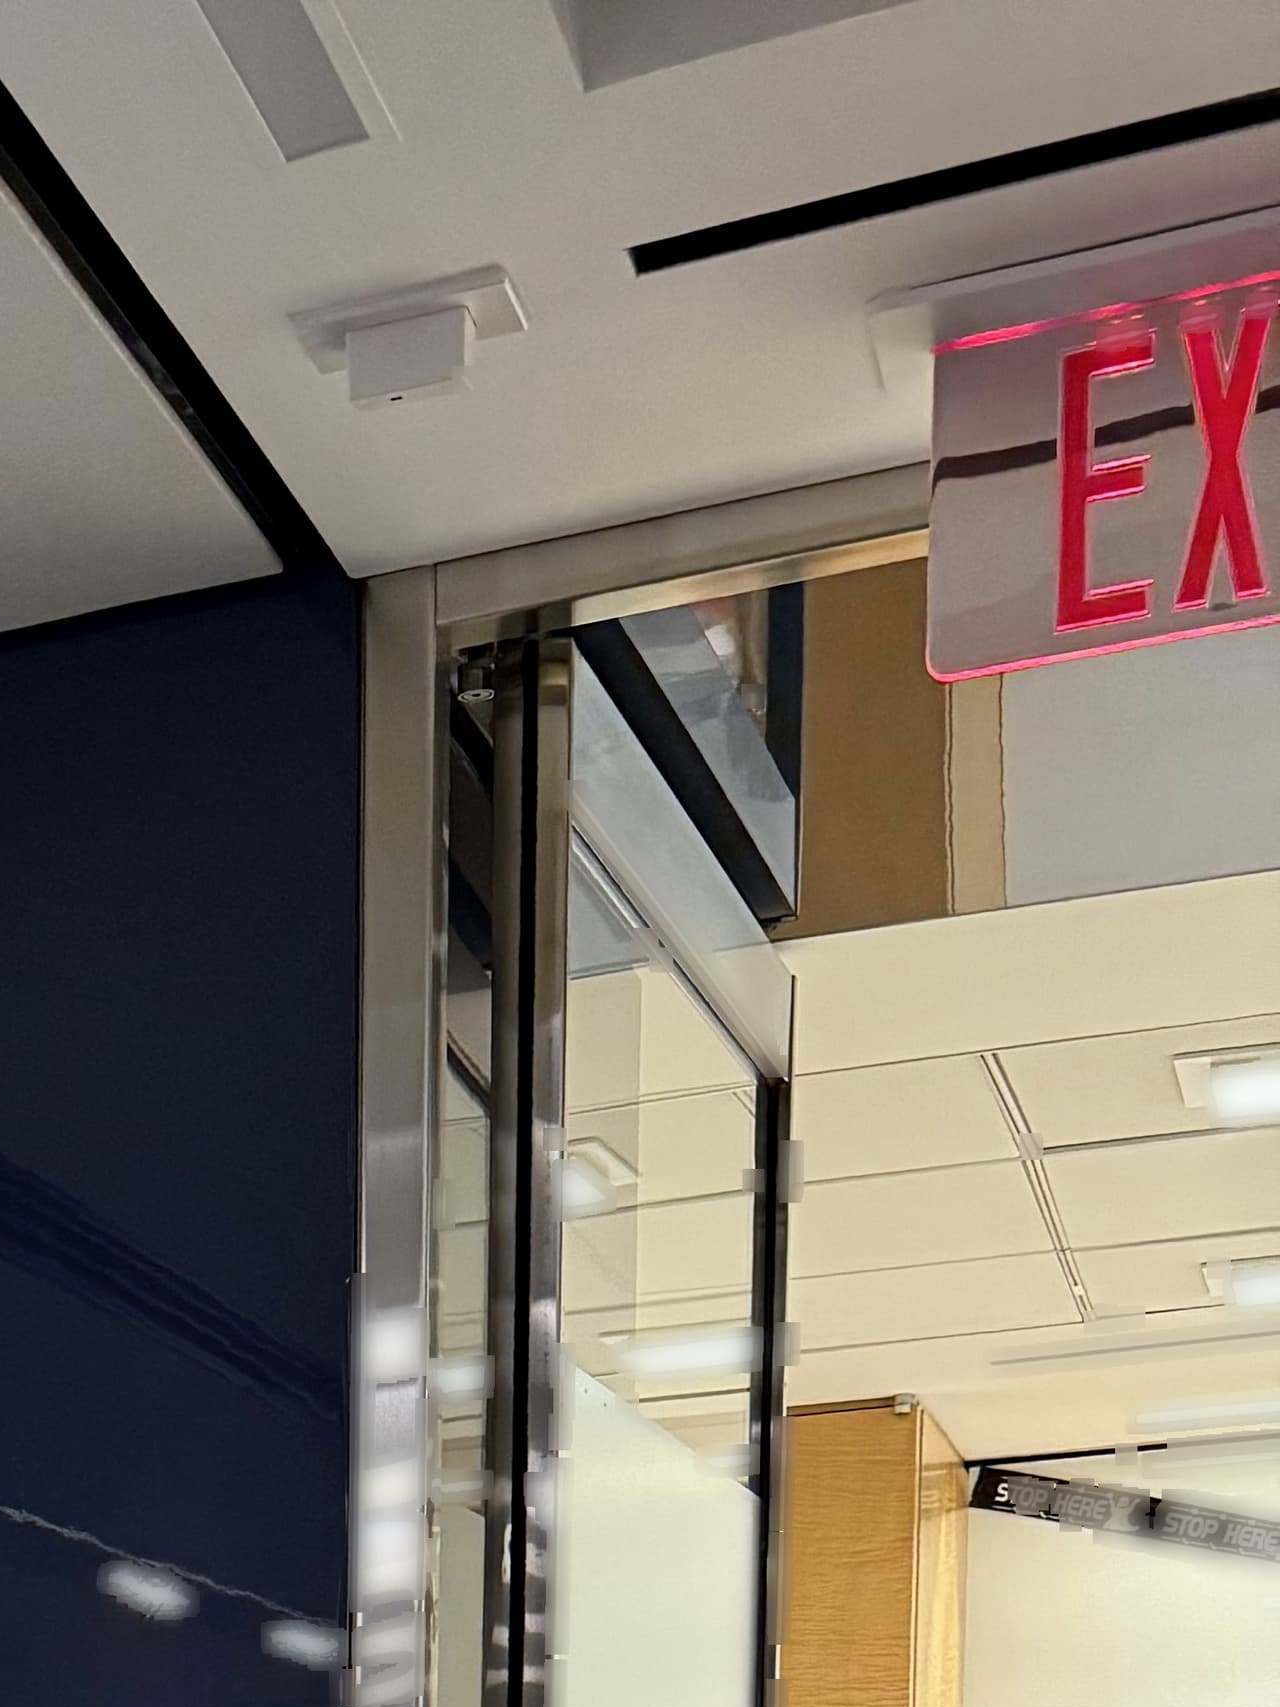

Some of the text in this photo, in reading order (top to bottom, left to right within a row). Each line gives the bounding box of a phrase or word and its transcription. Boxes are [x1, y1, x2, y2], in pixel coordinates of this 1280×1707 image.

[994, 1482, 1109, 1521] STOP HERE
[1161, 1510, 1280, 1552] STOP HERE
